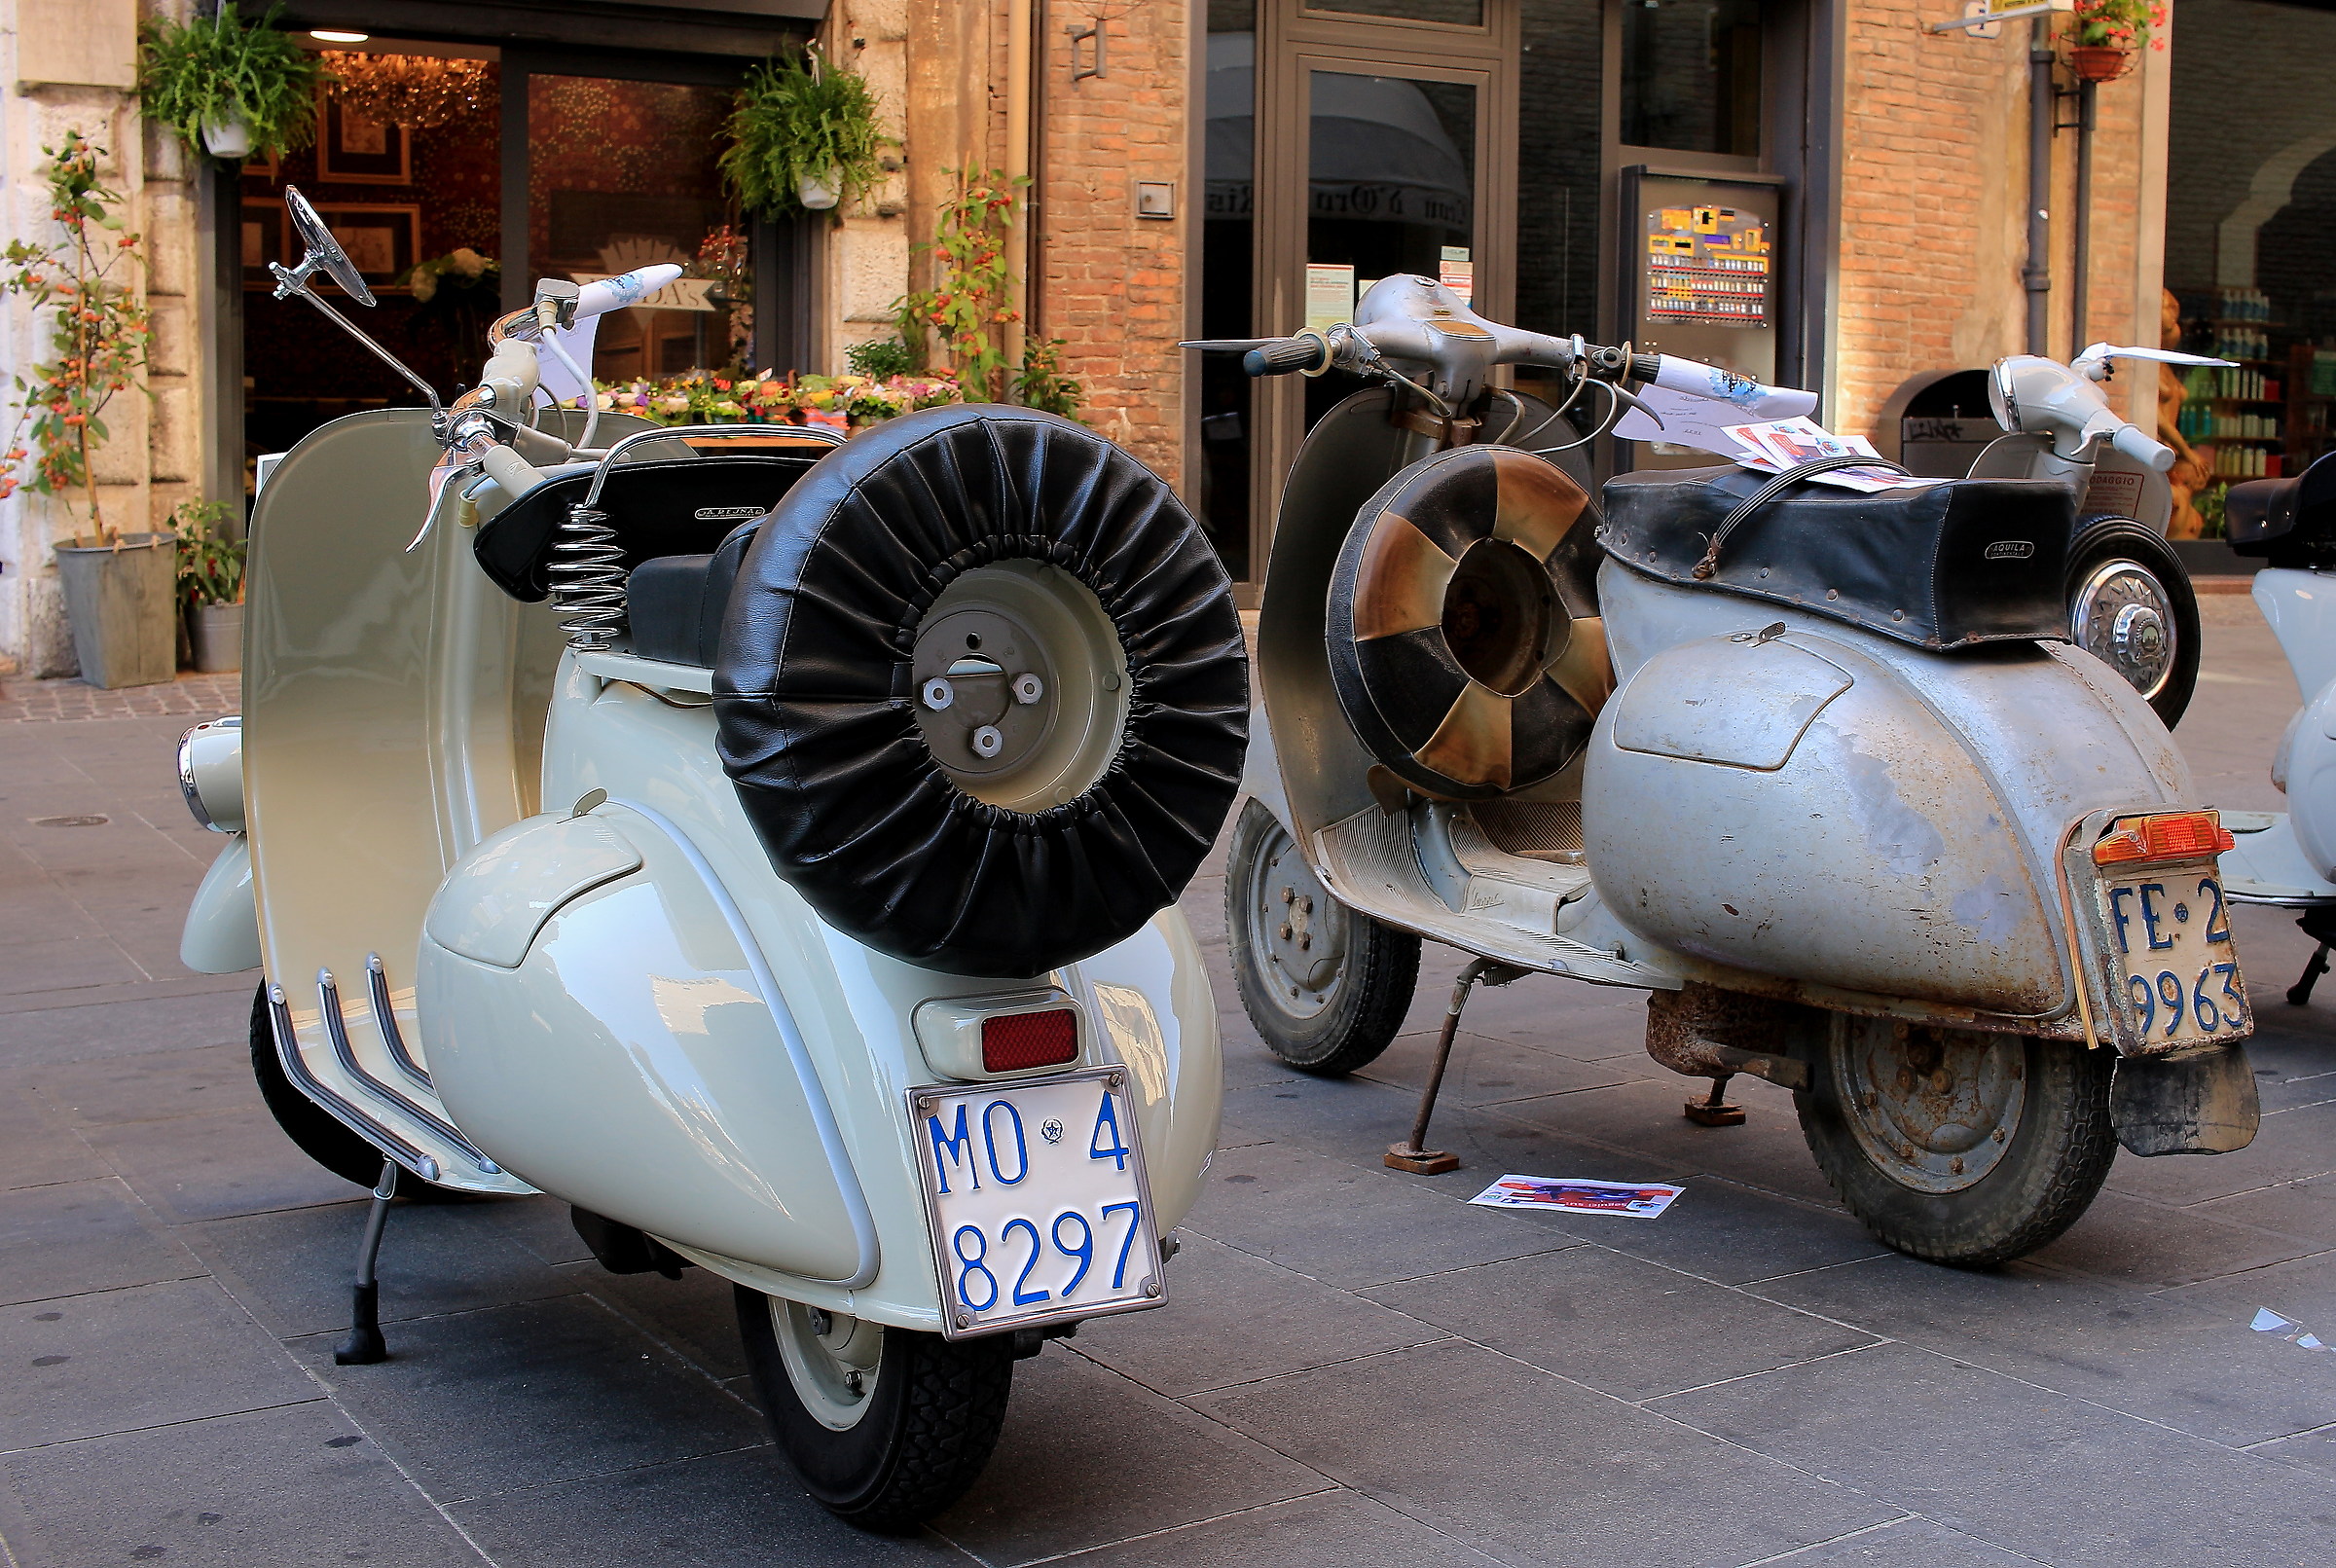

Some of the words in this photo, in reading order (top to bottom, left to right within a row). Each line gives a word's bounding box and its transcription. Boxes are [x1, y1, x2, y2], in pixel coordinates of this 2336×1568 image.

[1993, 543, 2025, 552] AQUILA
[2109, 883, 2172, 954] FE
[2197, 878, 2231, 944] 2
[2128, 963, 2245, 1037] 9963
[928, 1099, 1029, 1195] MO
[1089, 1088, 1131, 1171] 4
[953, 1200, 1142, 1312] 8297
